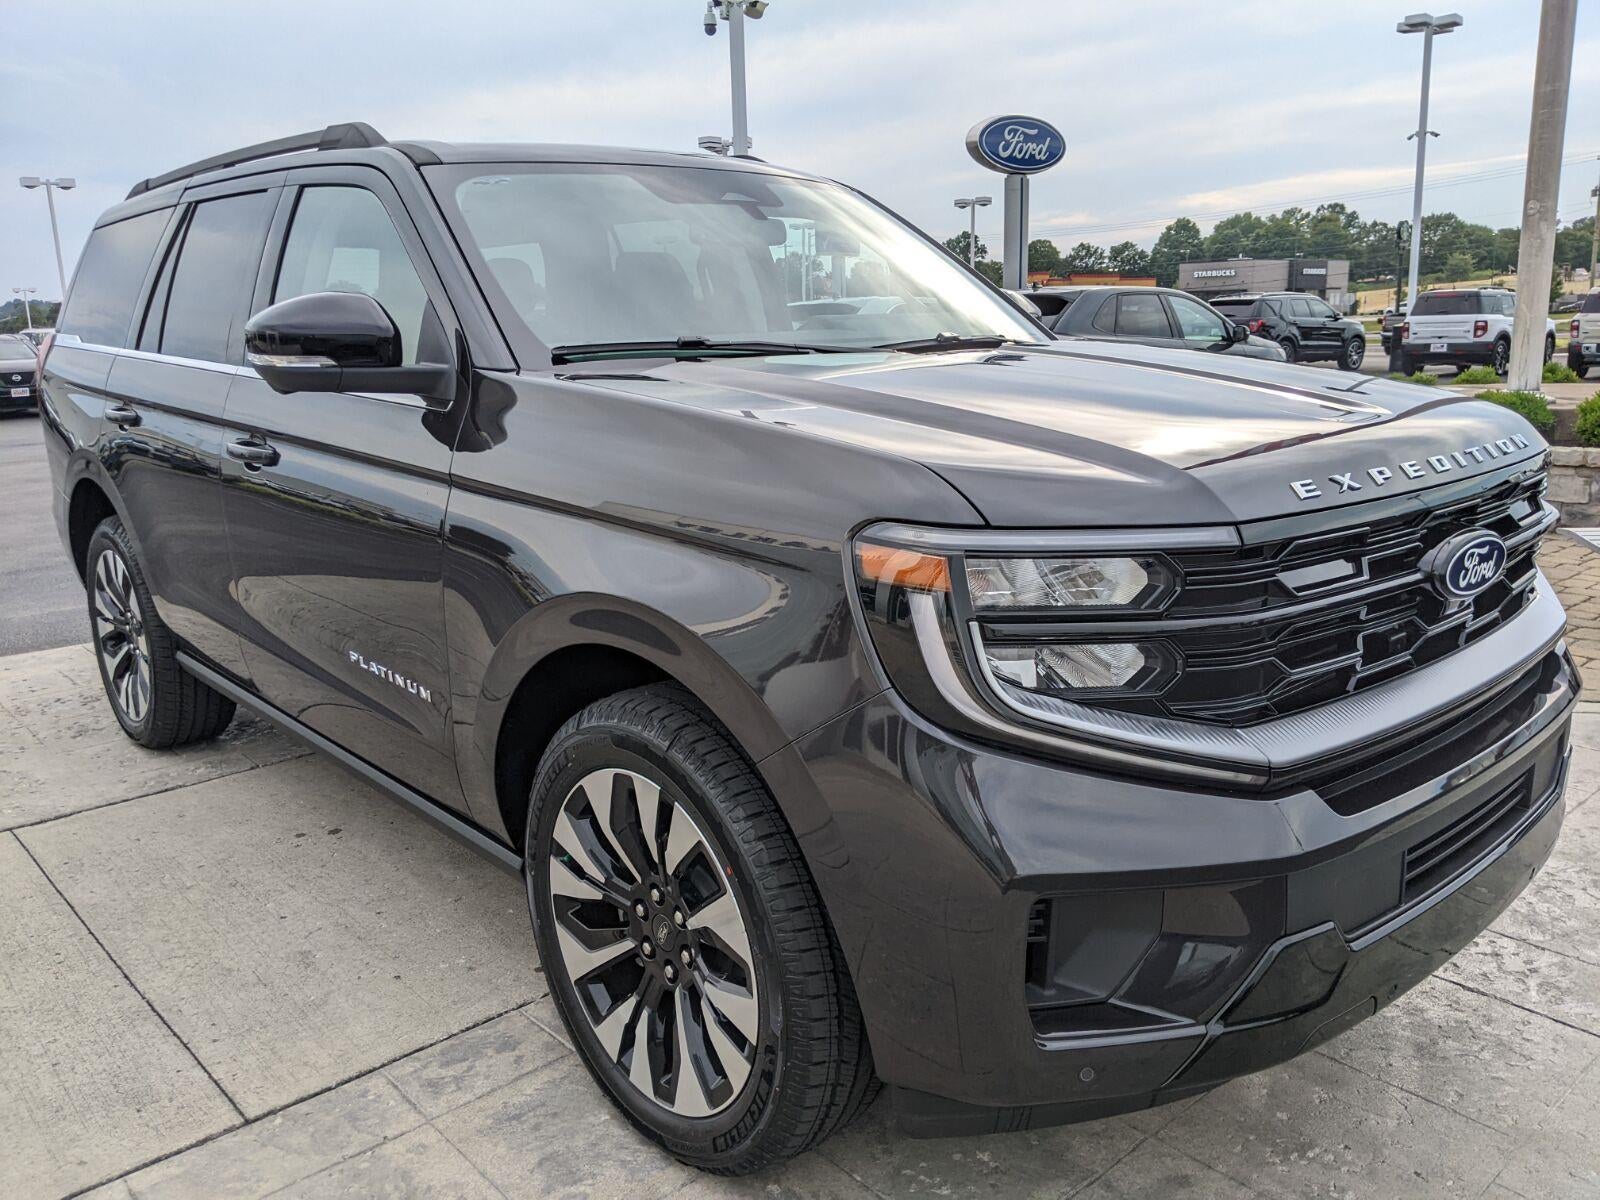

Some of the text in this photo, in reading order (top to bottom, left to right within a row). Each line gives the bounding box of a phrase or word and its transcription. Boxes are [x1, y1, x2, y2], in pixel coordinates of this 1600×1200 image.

[998, 125, 1051, 160] Ford
[1193, 269, 1236, 278] STARBUCKS
[1290, 433, 1529, 500] EXPEDITION
[1459, 545, 1498, 588] Ford
[349, 650, 432, 703] PLATINUM
